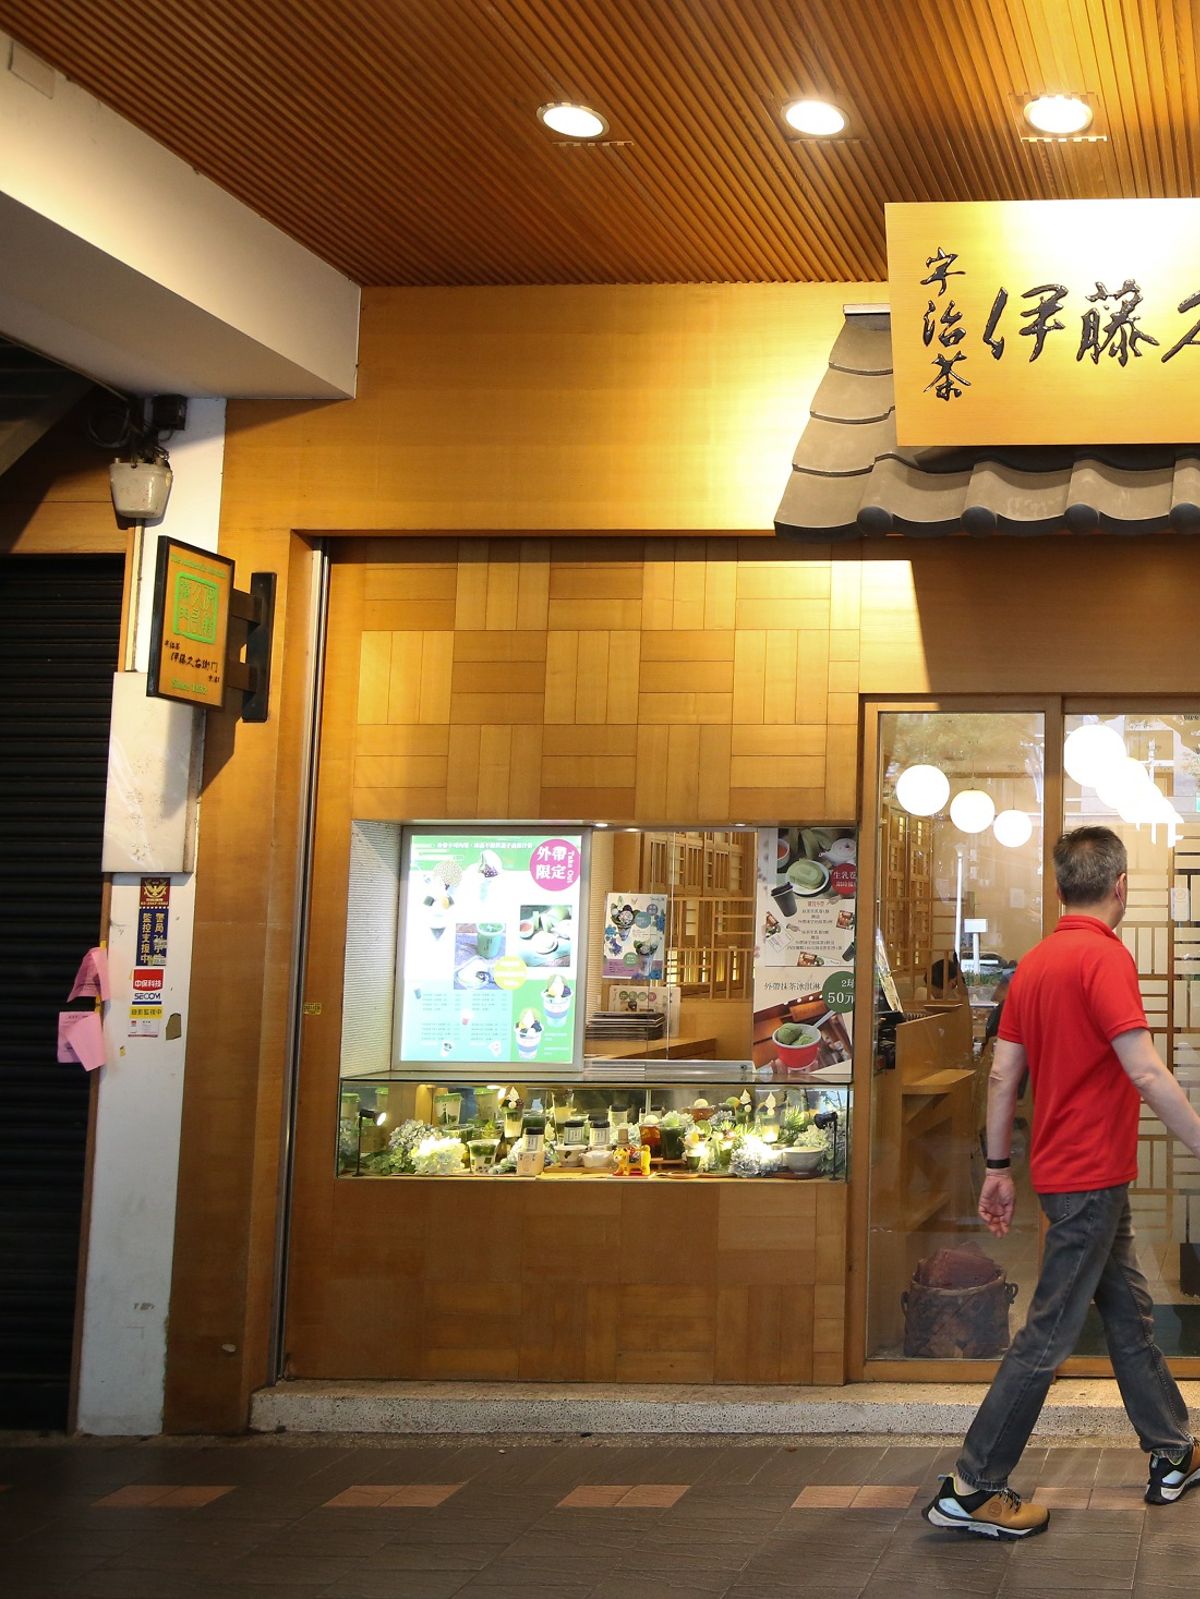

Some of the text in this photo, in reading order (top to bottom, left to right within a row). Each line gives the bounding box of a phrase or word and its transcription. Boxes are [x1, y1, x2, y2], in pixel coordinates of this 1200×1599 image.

[919, 246, 972, 401] 宇治茶
[536, 845, 567, 861] 外帶
[535, 864, 567, 880] 限定
[134, 992, 161, 1001] SECOM
